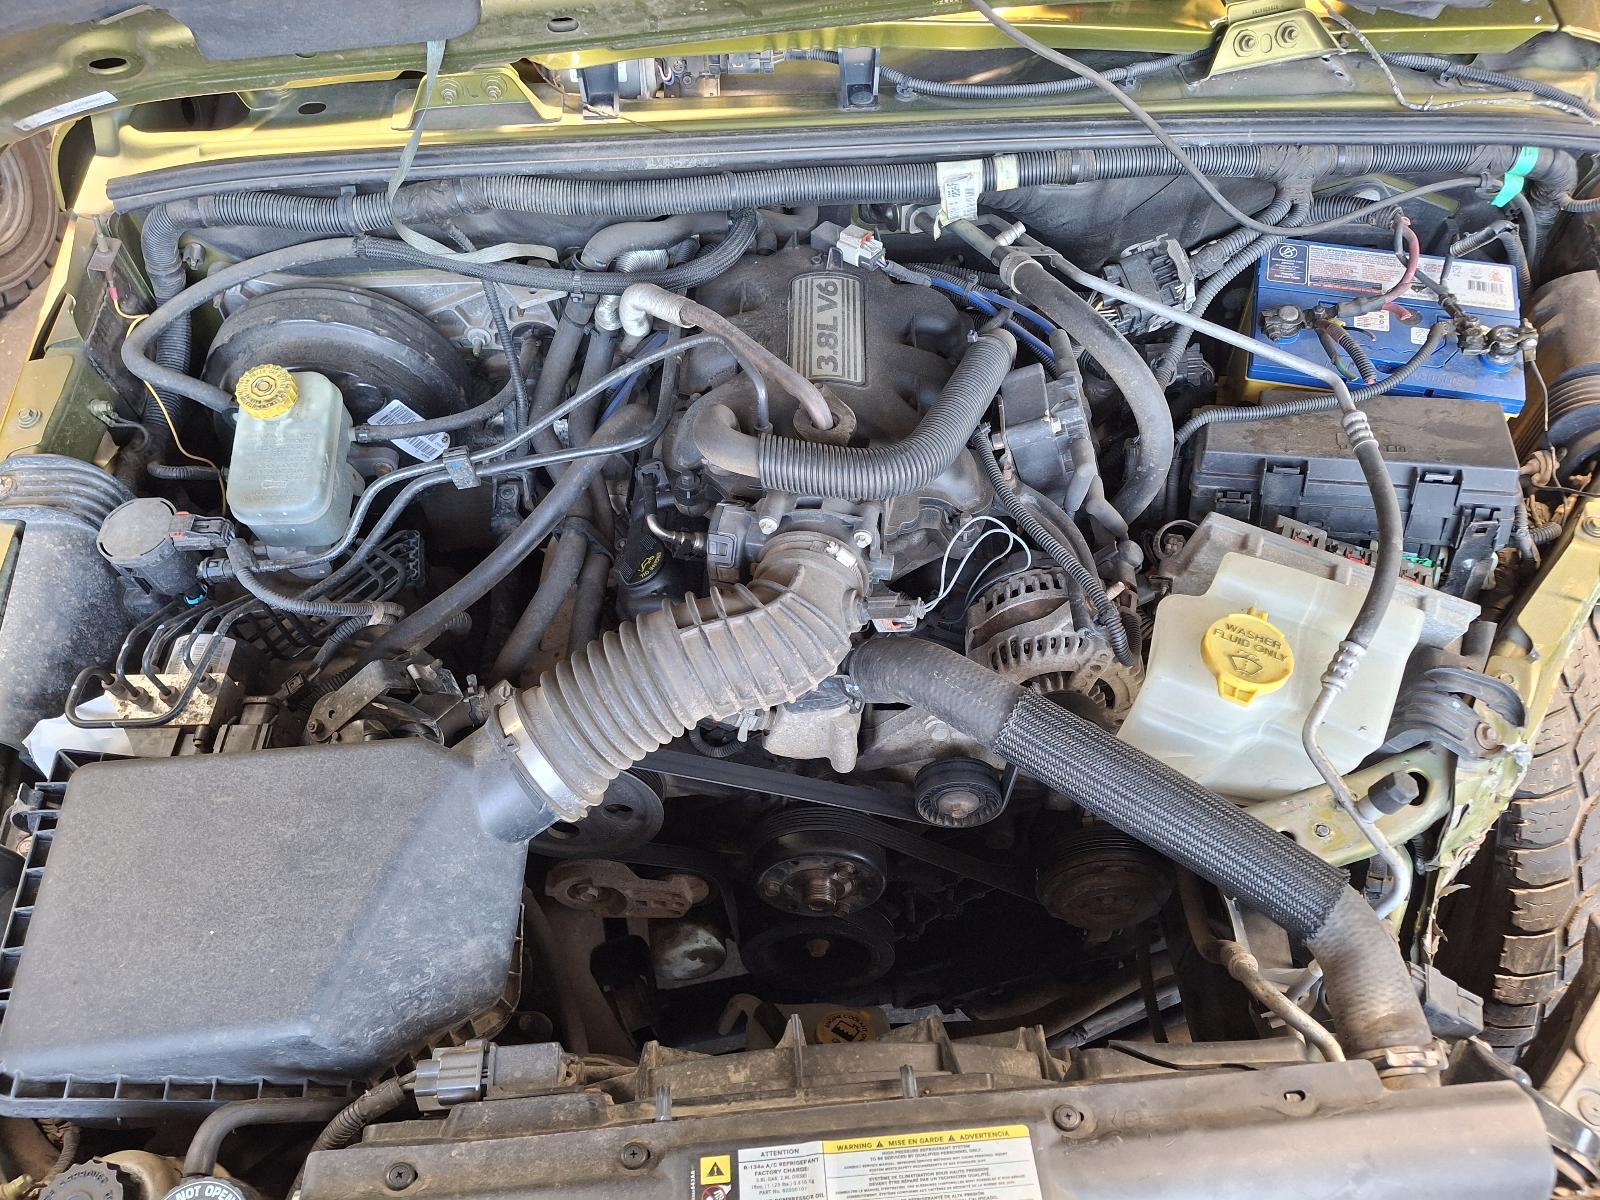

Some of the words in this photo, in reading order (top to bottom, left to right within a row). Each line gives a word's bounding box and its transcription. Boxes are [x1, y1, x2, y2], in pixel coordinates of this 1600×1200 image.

[816, 280, 838, 313] V6
[816, 316, 838, 372] 3.8L
[1225, 623, 1282, 650] WASHER
[1214, 628, 1250, 648] FLUID
[1254, 644, 1288, 662] ONLY
[960, 1130, 1010, 1140] ADVERTENCIA
[760, 1148, 799, 1158] ATTENTION
[837, 1142, 872, 1151] WARNING
[779, 1157, 819, 1167] REFRIGERANT
[175, 1185, 201, 1200] NOT
